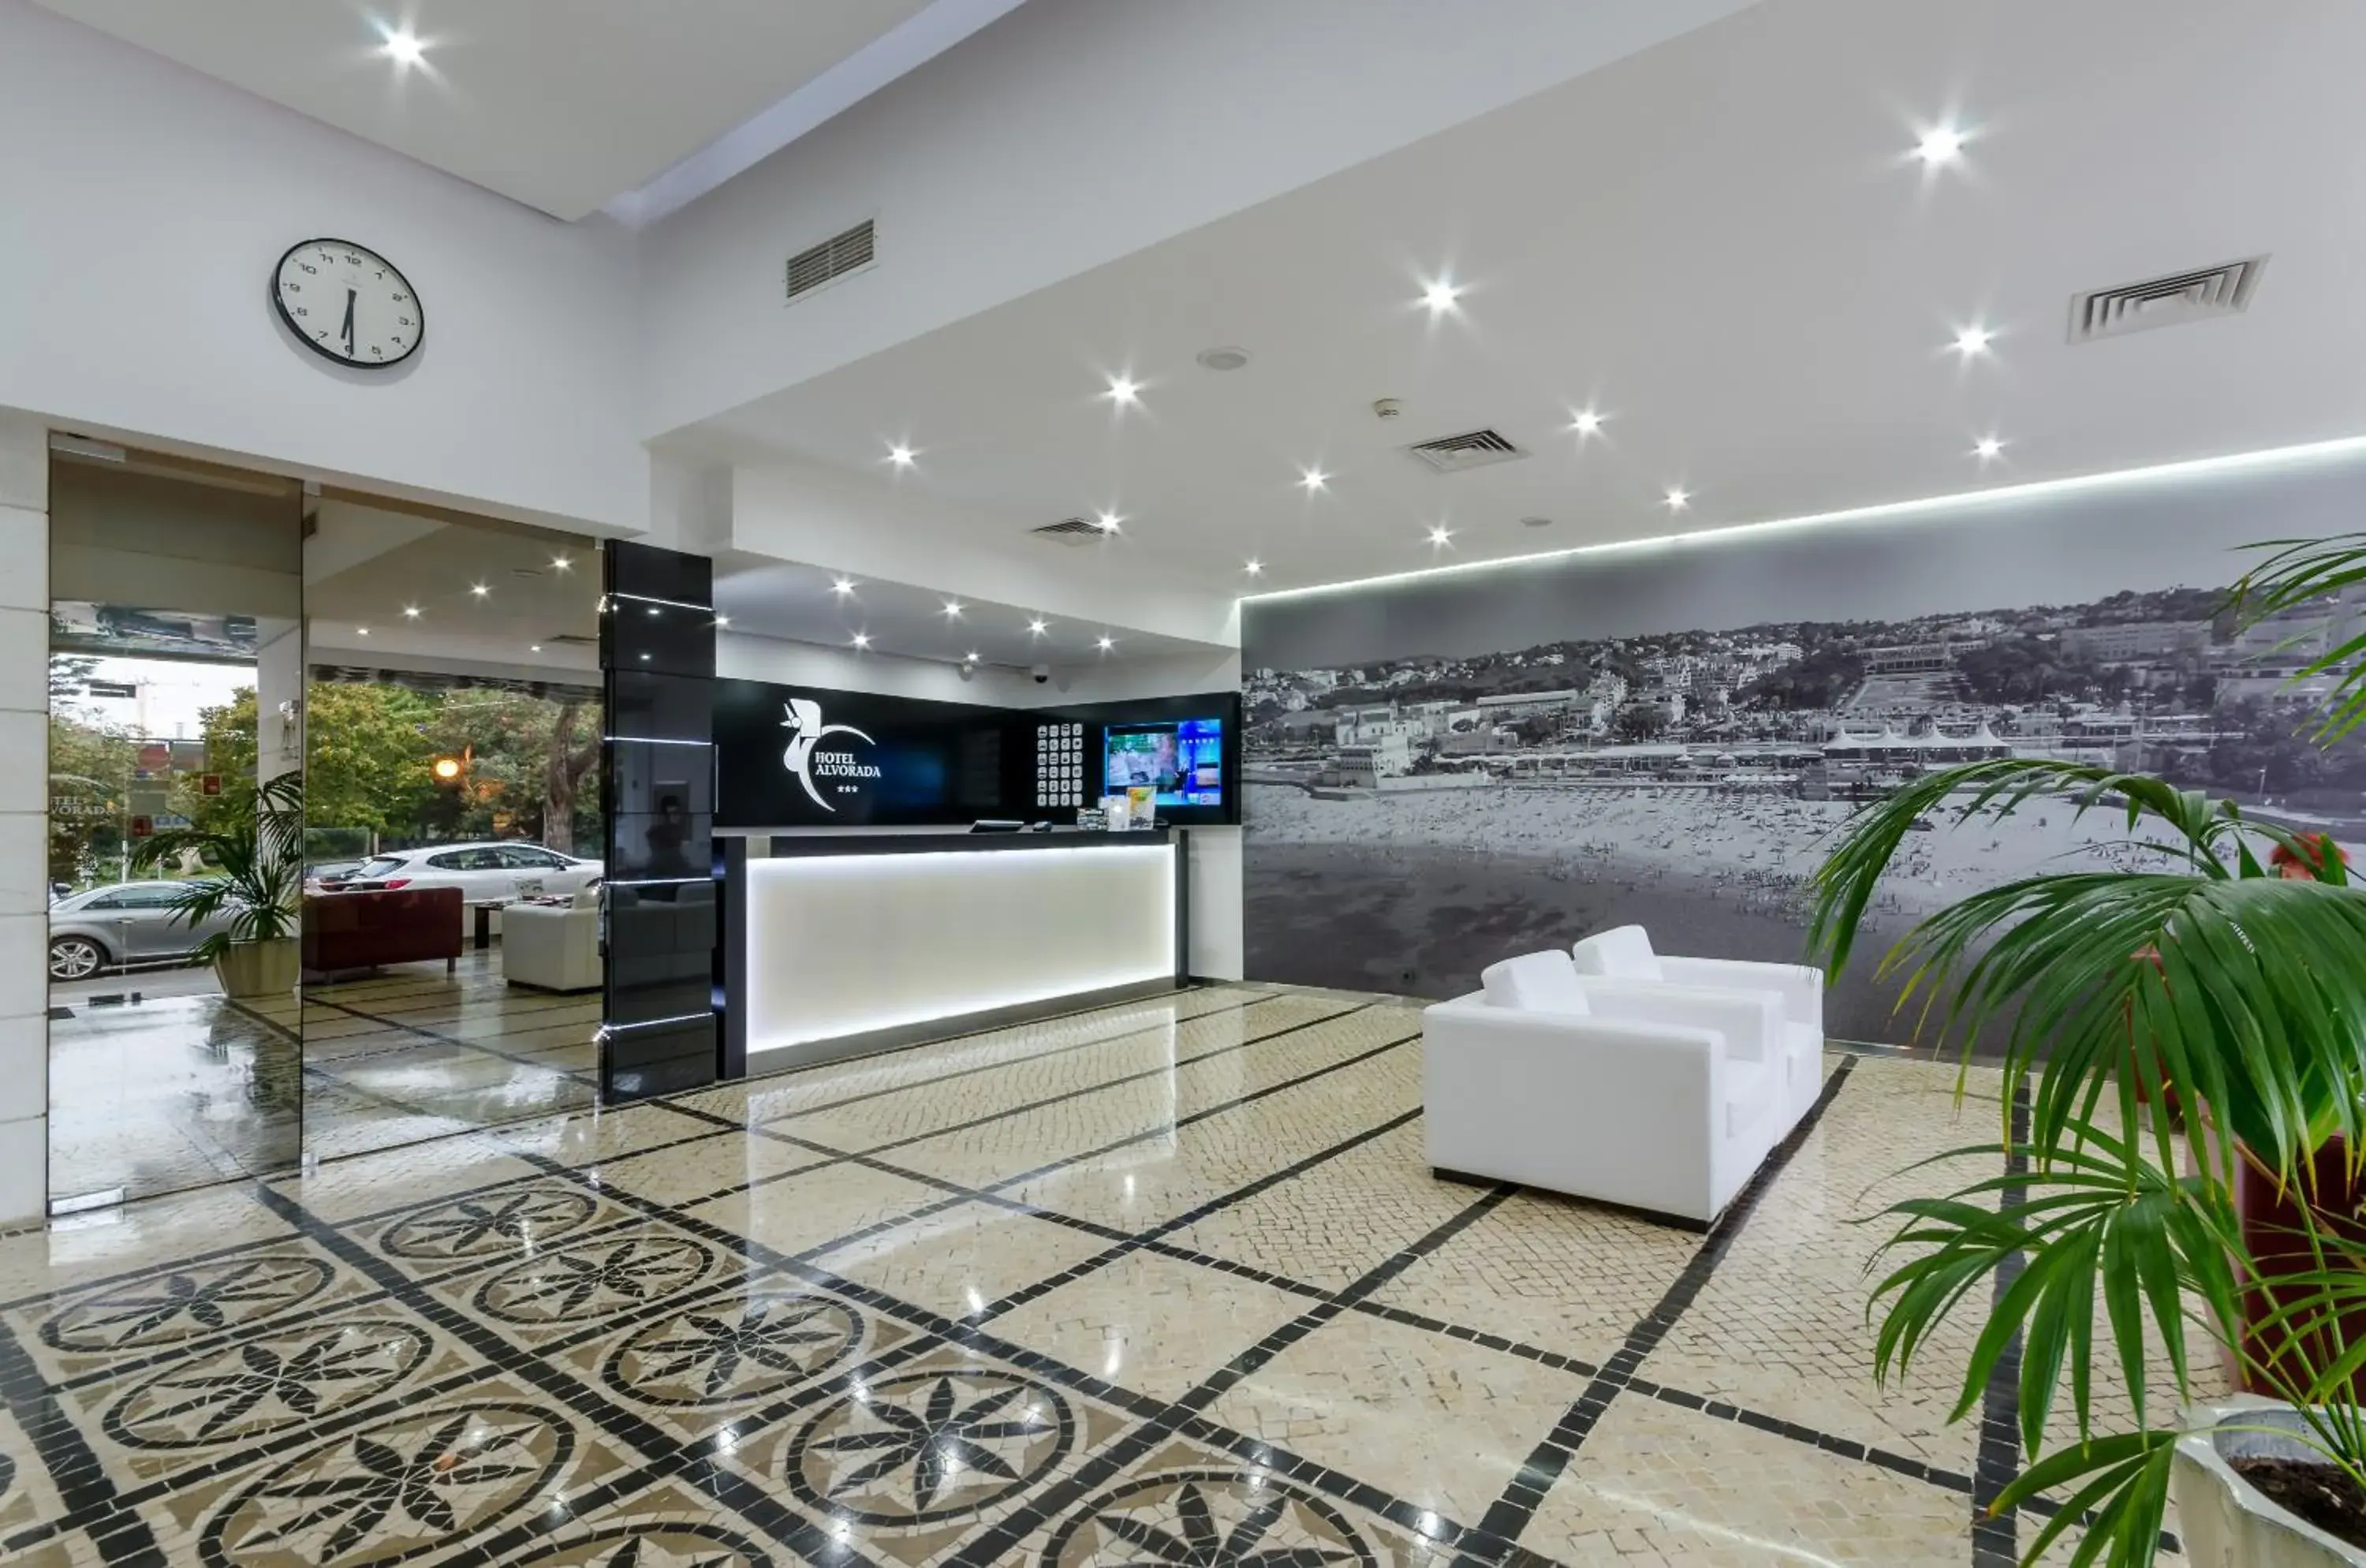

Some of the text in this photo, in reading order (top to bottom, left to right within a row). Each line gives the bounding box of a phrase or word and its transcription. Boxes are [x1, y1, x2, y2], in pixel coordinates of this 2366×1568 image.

[815, 752, 856, 764] HOTEL
[815, 764, 882, 778] ALVORADA
[50, 796, 82, 805] TEL
